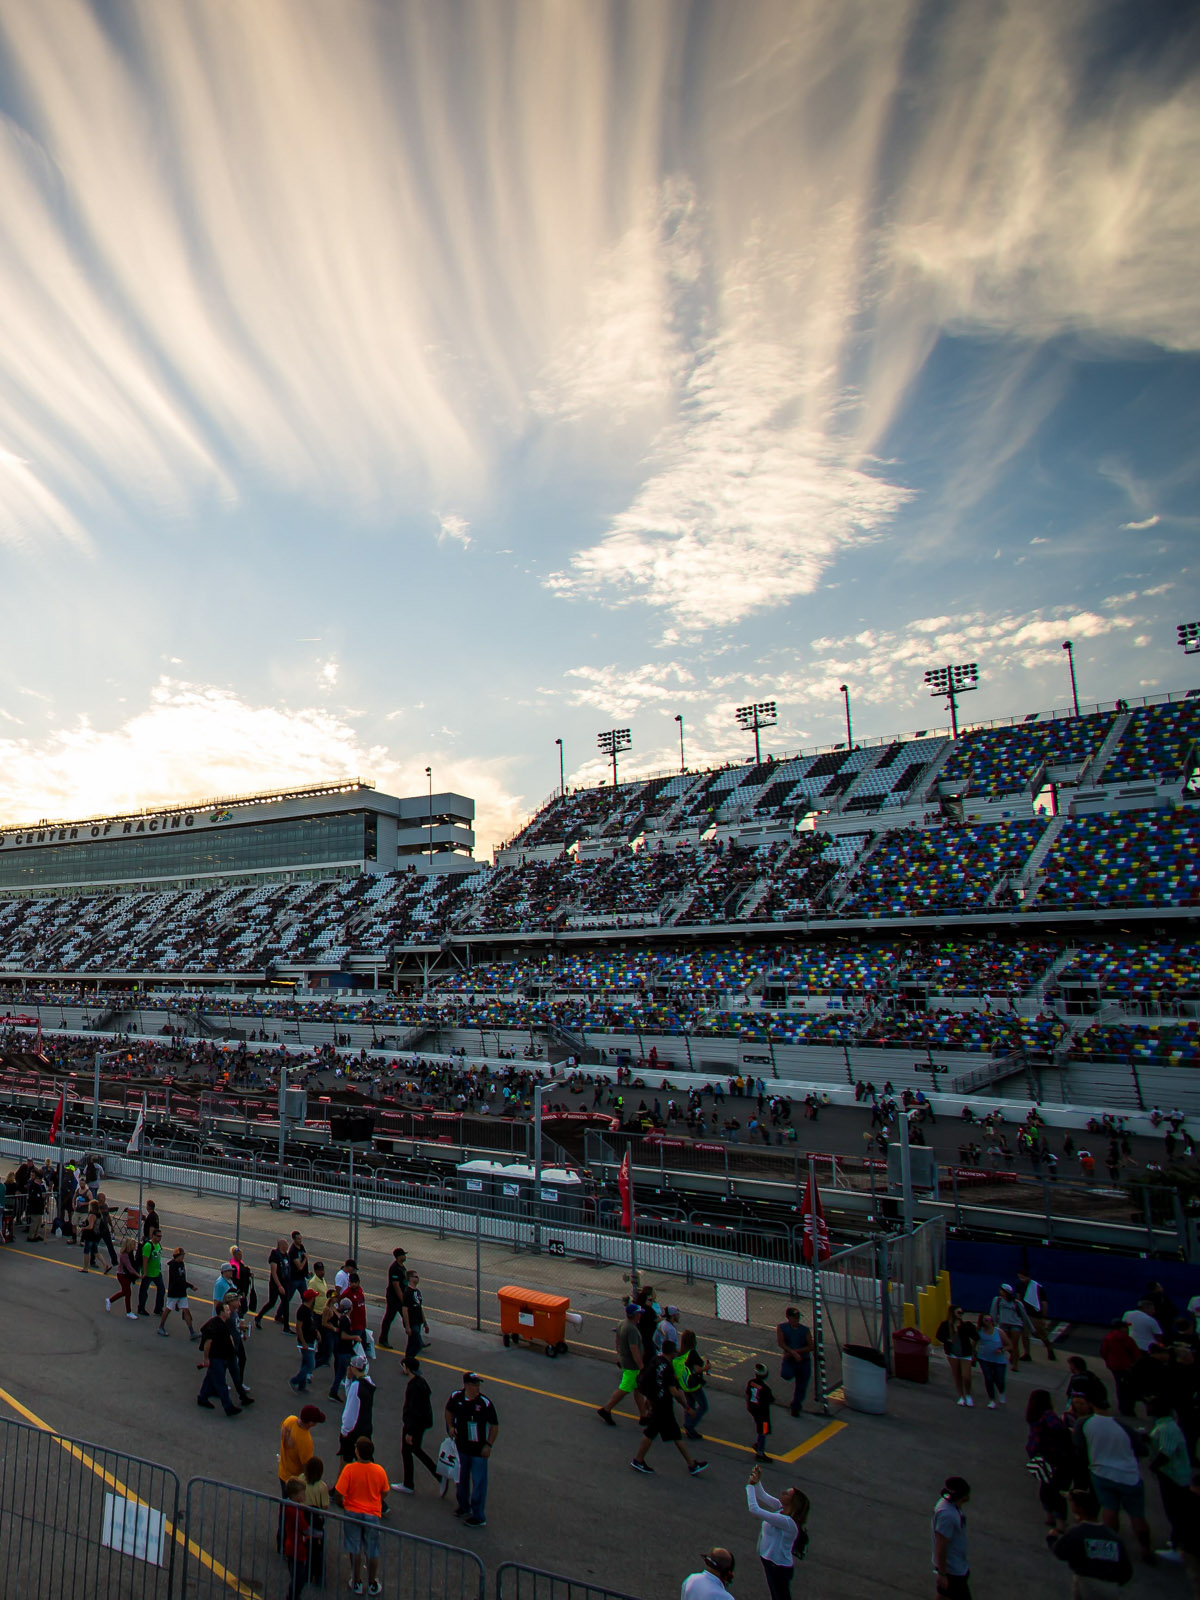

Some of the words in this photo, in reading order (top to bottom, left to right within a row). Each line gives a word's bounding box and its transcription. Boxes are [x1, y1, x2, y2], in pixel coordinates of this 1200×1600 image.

[15, 829, 79, 845] CENTER
[91, 824, 112, 837] OF
[123, 815, 194, 834] RACING
[280, 1199, 290, 1208] 42
[550, 1243, 564, 1254] 43
